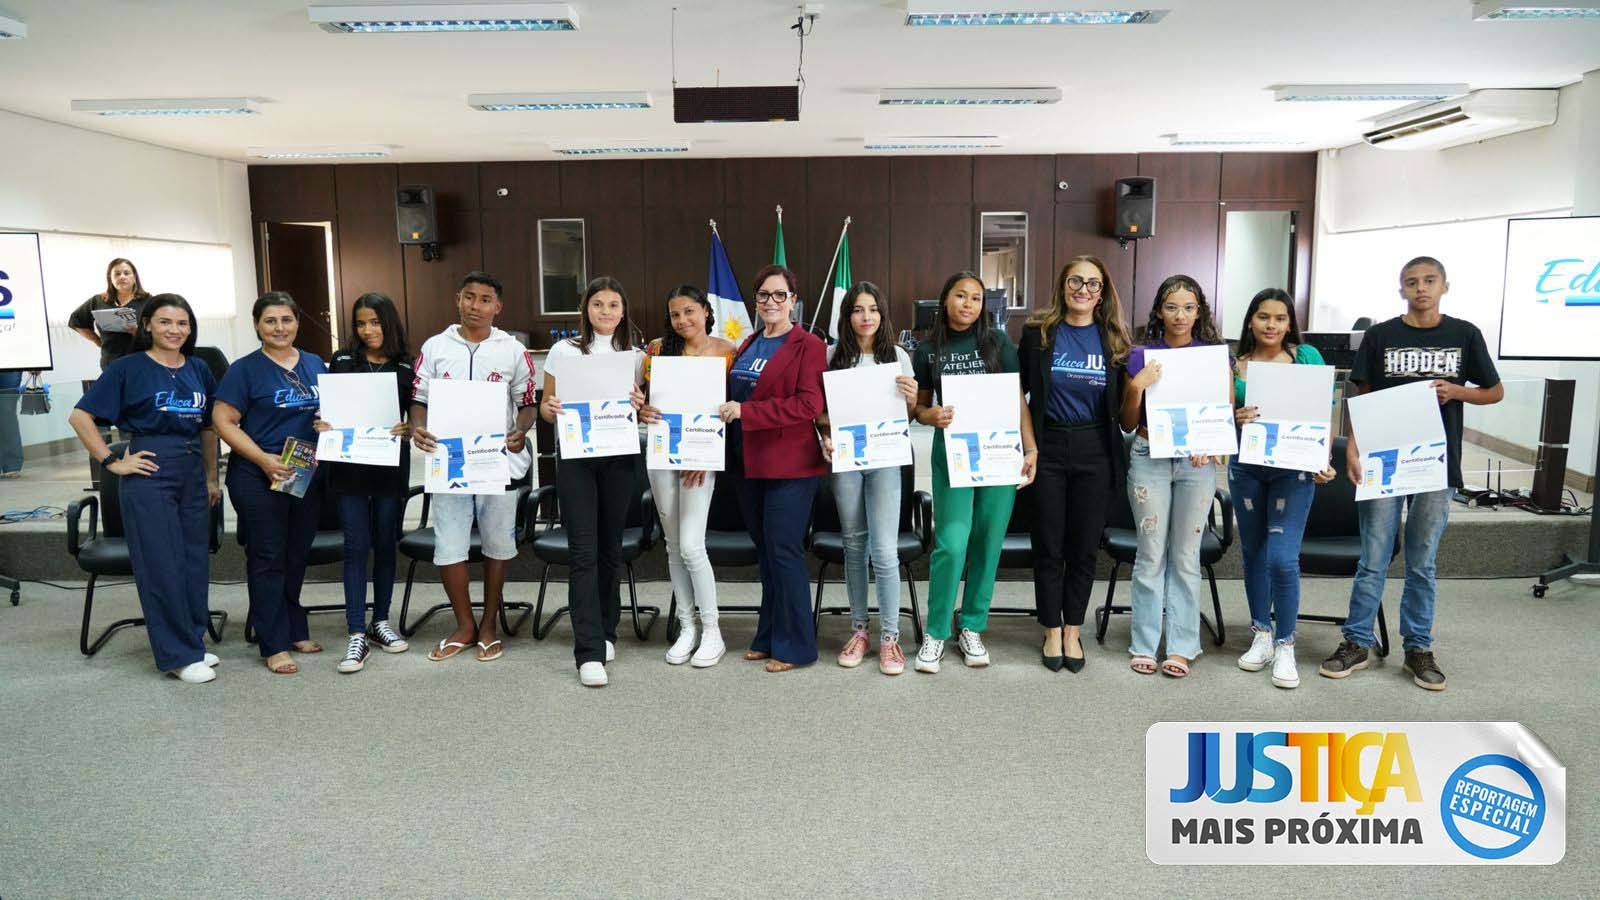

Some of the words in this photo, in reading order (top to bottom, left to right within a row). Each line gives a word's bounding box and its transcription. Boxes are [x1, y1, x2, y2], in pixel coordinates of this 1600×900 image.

[951, 353, 970, 362] For
[1388, 351, 1457, 373] HIDDEN
[943, 360, 986, 370] ATELIER
